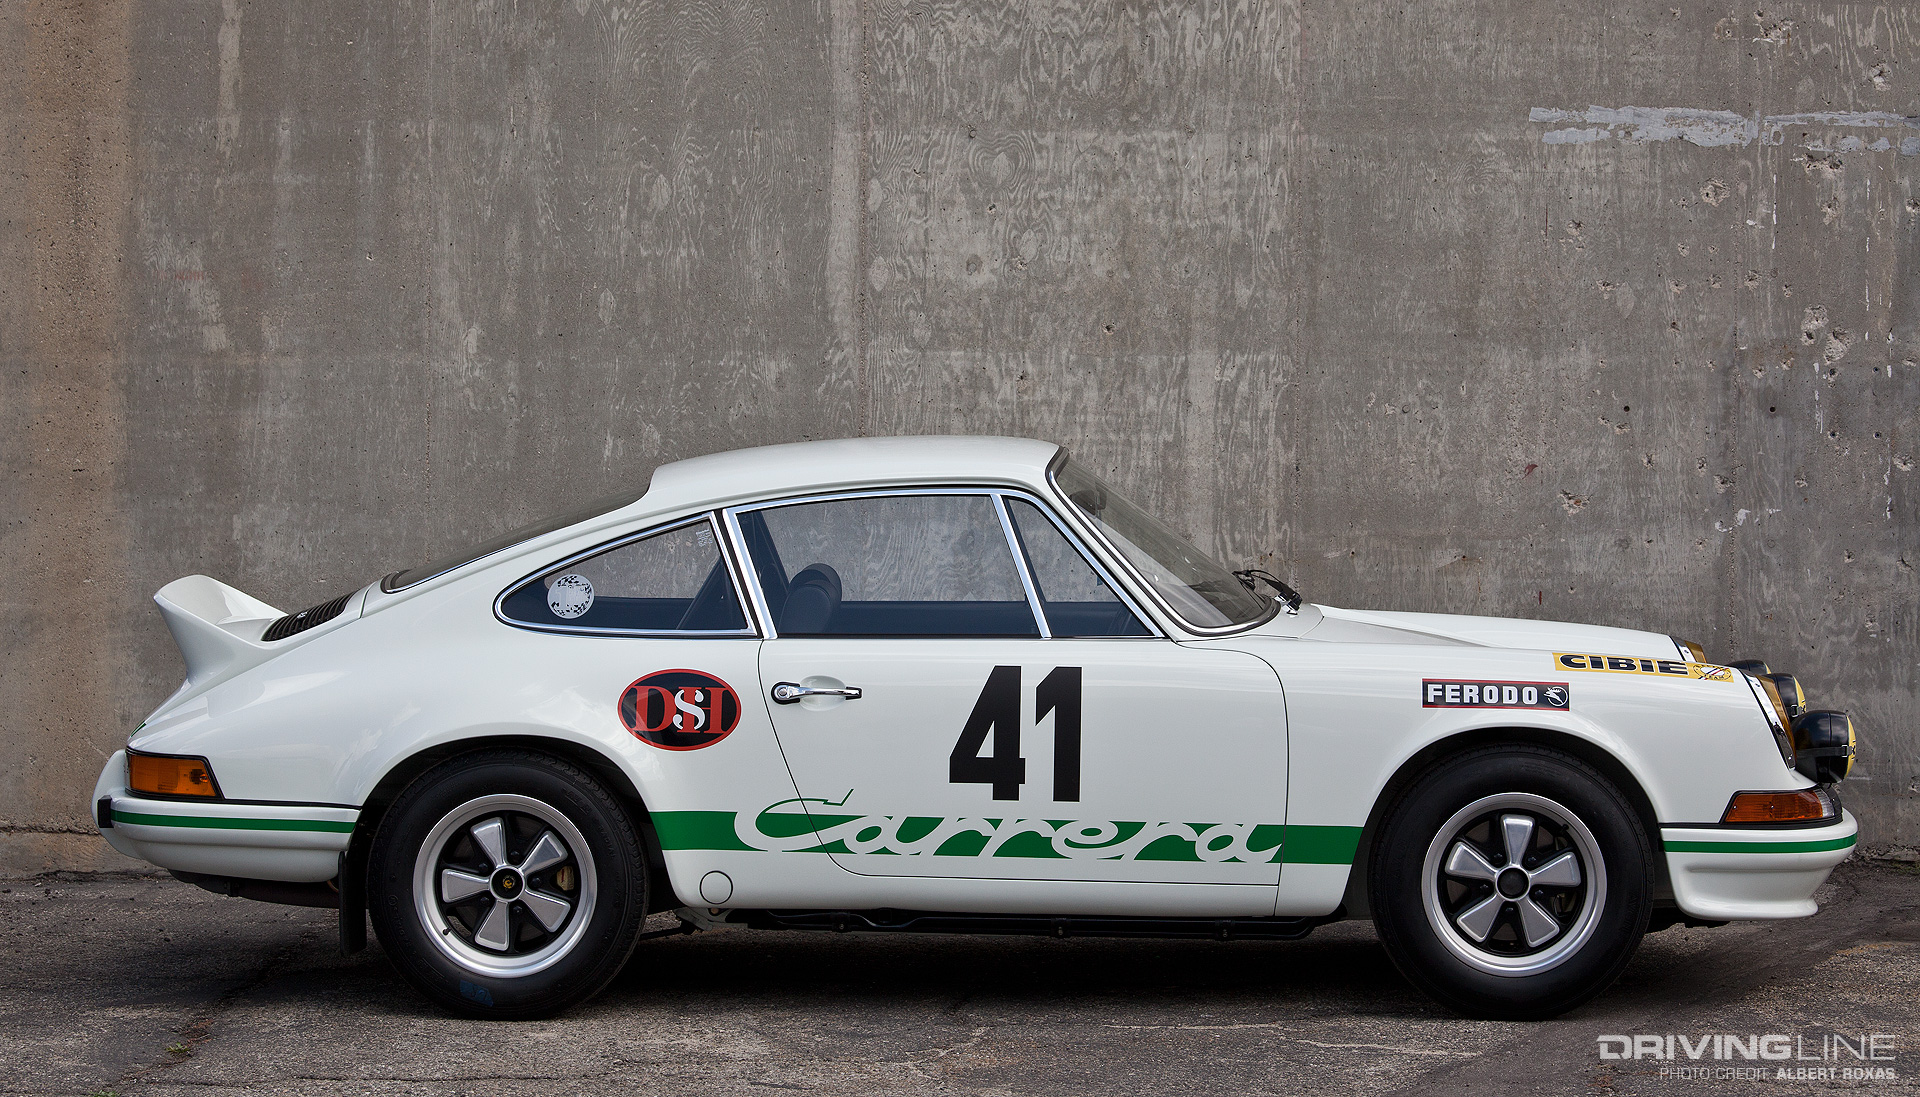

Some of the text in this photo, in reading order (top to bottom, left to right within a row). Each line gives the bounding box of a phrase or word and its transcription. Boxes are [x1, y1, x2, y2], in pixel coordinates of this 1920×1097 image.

[1559, 653, 1689, 675] CIBIE
[1427, 684, 1539, 706] FERODO
[948, 665, 1082, 802] 41
[734, 789, 1283, 864] Carrera
